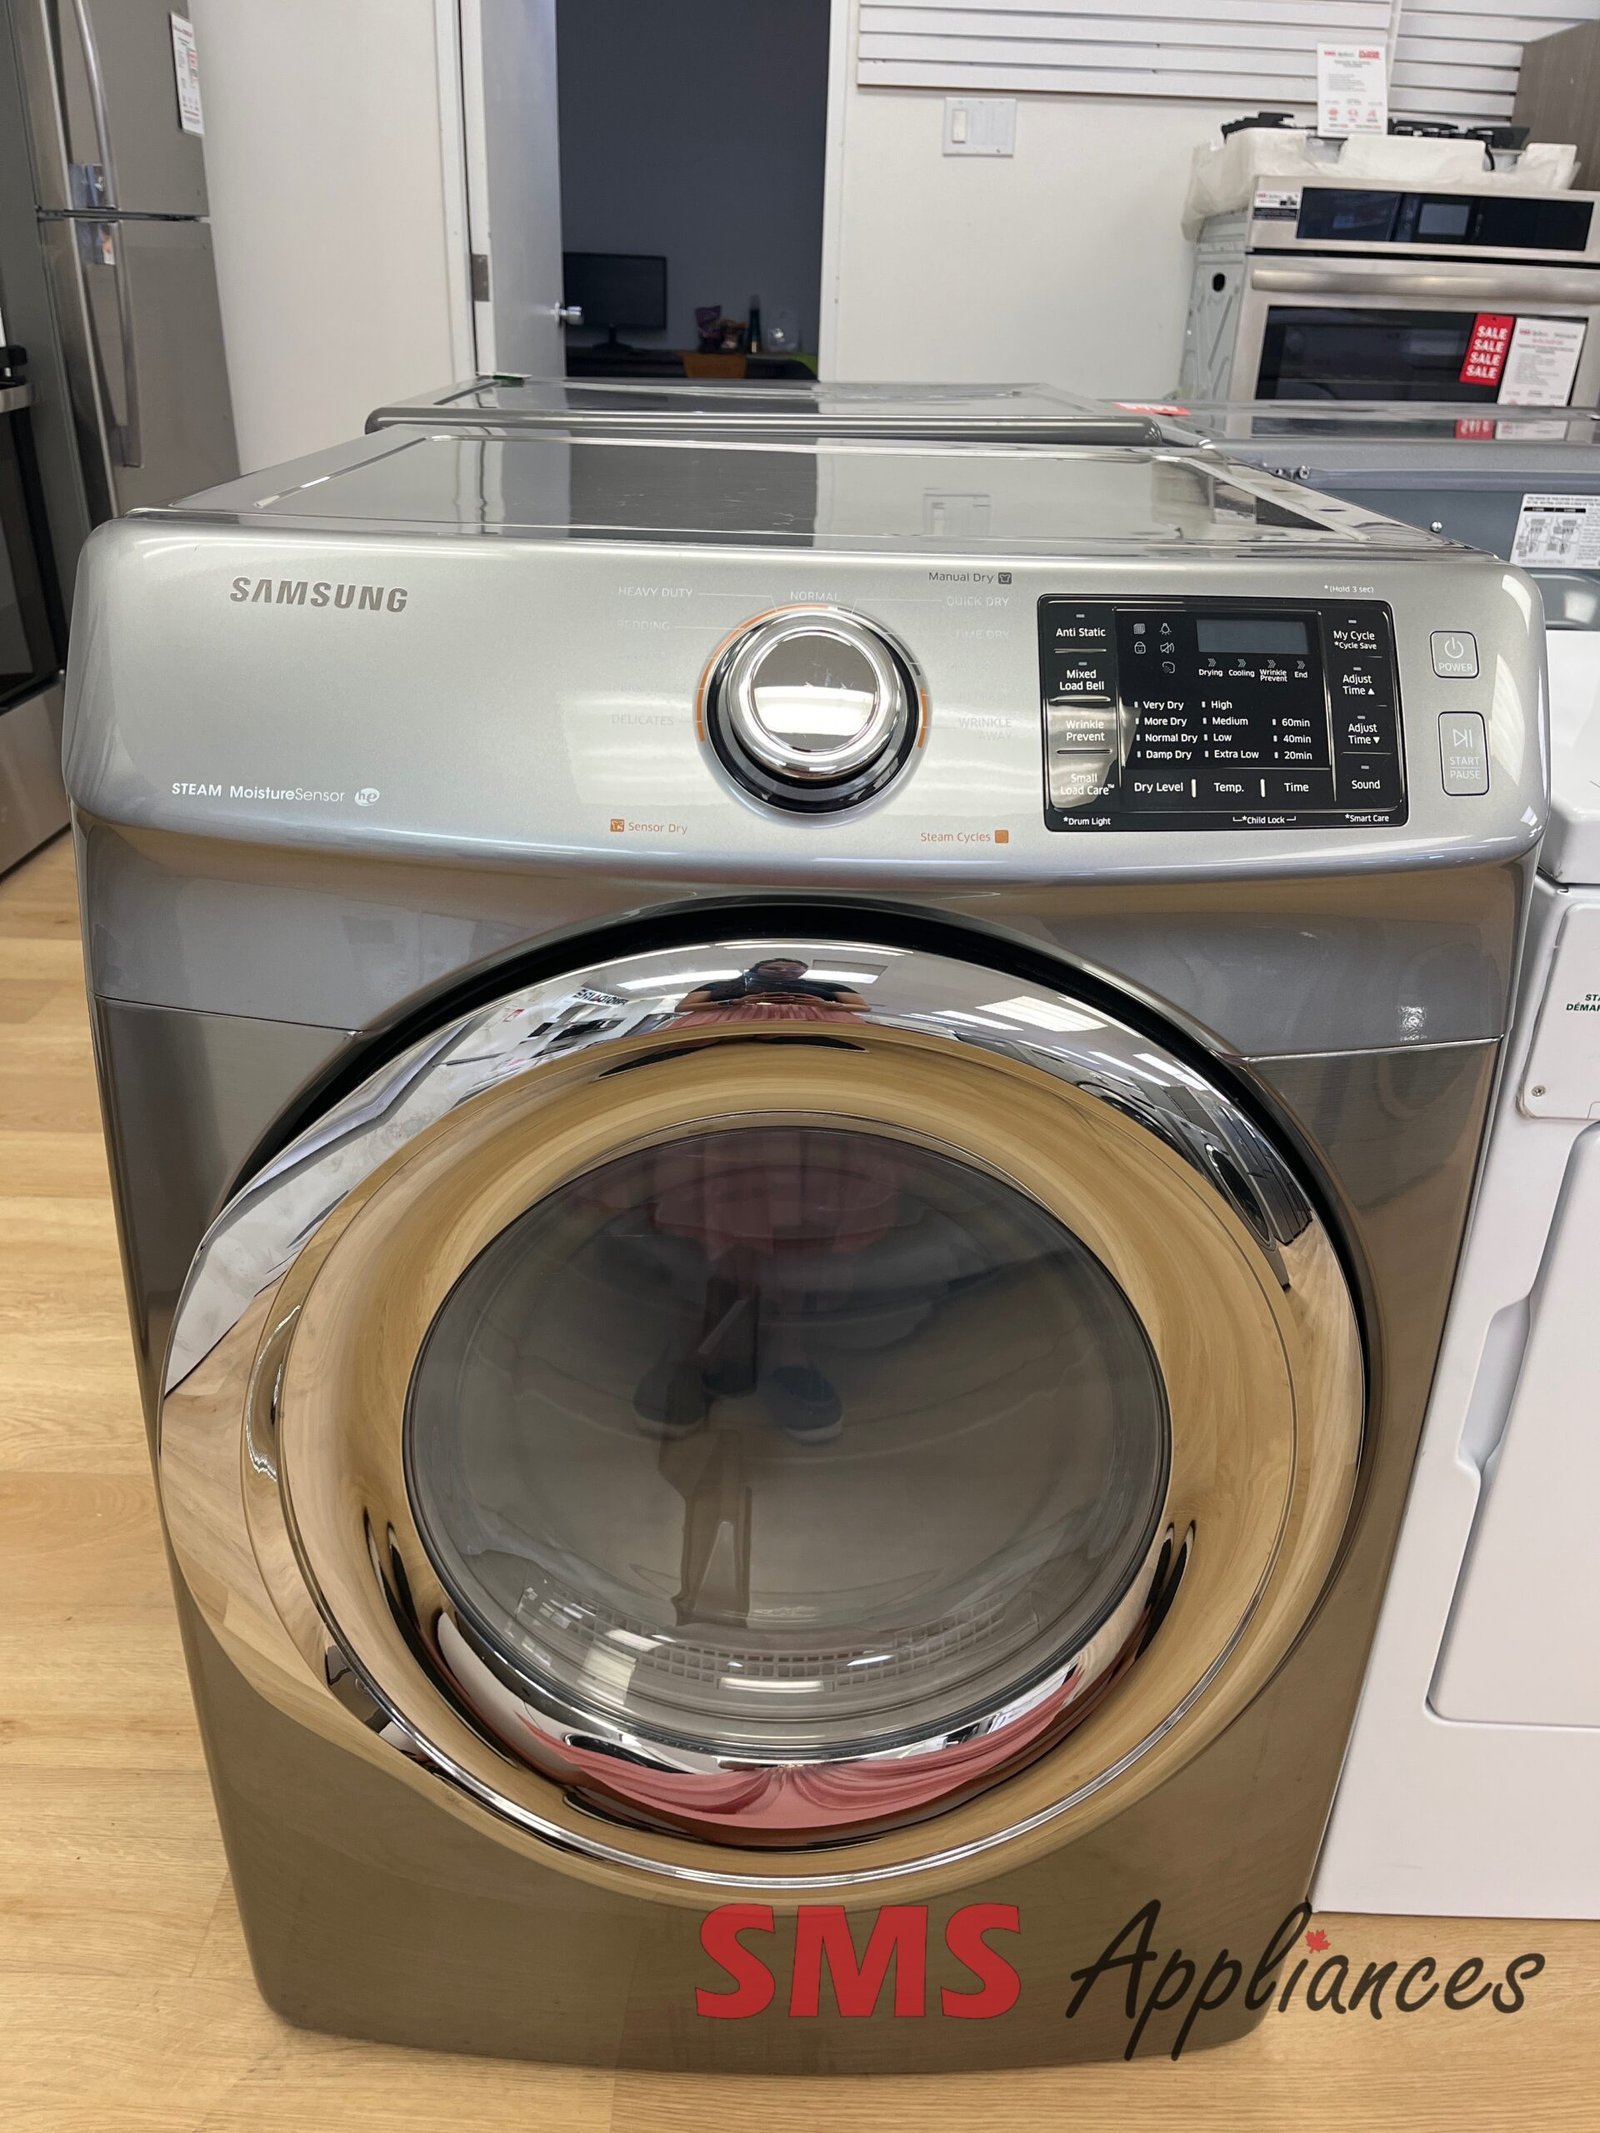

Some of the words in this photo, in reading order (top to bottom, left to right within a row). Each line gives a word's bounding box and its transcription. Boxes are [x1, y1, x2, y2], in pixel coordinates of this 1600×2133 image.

[1477, 326, 1508, 340] SALE
[1473, 339, 1504, 353] SALE
[1470, 352, 1500, 366] SALE
[1466, 365, 1497, 379] SALE
[928, 572, 969, 582] Manual
[973, 573, 994, 584] Dry
[230, 577, 408, 612] SAMSUNG
[618, 586, 658, 597] HEAVY
[661, 587, 693, 598] DUTY
[1359, 586, 1374, 594] sec)
[790, 591, 839, 601] NORMAL
[946, 596, 982, 607] QUICK
[986, 597, 1010, 607] DRY
[1056, 627, 1076, 637] Anti
[1079, 627, 1106, 637] Static
[1333, 630, 1348, 640] My
[1350, 630, 1375, 641] Cycle
[1438, 662, 1473, 672] POWER
[1066, 669, 1097, 679] Mixed
[1199, 669, 1223, 677] Drying
[1229, 669, 1255, 677] Cooling
[1260, 674, 1288, 682] Prevent
[1342, 674, 1373, 685] Adjust
[1059, 681, 1083, 691] Load
[1086, 681, 1105, 691] Bell
[1342, 685, 1366, 695] Time
[1143, 700, 1165, 711] Very
[1167, 700, 1184, 711] Dry
[1211, 700, 1233, 710] High
[958, 716, 1013, 729] WRINKLE
[1066, 720, 1105, 729] Wrinkle
[1144, 717, 1168, 726] More
[1171, 717, 1188, 727] Dry
[1212, 717, 1249, 726] Medium
[1281, 718, 1311, 728] 60min
[1348, 723, 1378, 734] Adjust
[1066, 732, 1105, 742] Prevent
[1145, 733, 1179, 742] Normal
[1181, 733, 1199, 744] Dry
[1213, 733, 1232, 742] Low
[1283, 734, 1312, 744] 40min
[1348, 735, 1372, 745] Time
[1146, 750, 1173, 760] Damp
[1175, 750, 1193, 761] Dry
[1214, 750, 1239, 759] Extra
[1241, 750, 1260, 759] Low
[1284, 751, 1313, 760] 20min
[1450, 756, 1480, 766] START
[1071, 773, 1098, 783] Small
[1450, 769, 1481, 780] PAUSE
[1134, 782, 1154, 793] Dry
[1156, 782, 1184, 792] Level
[1213, 782, 1245, 793] Temp.
[1284, 782, 1310, 793] Time
[1351, 780, 1381, 790] Sound
[171, 783, 222, 797] STEAM
[229, 786, 345, 802] MoistureSensor
[1060, 786, 1084, 795] Load
[1092, 818, 1111, 827] Light
[1267, 816, 1286, 824] Lock
[1373, 814, 1390, 822] Care
[628, 821, 665, 833] Sensor
[668, 822, 688, 834] Dry
[920, 831, 954, 842] Steam
[957, 831, 991, 843] Cycles
